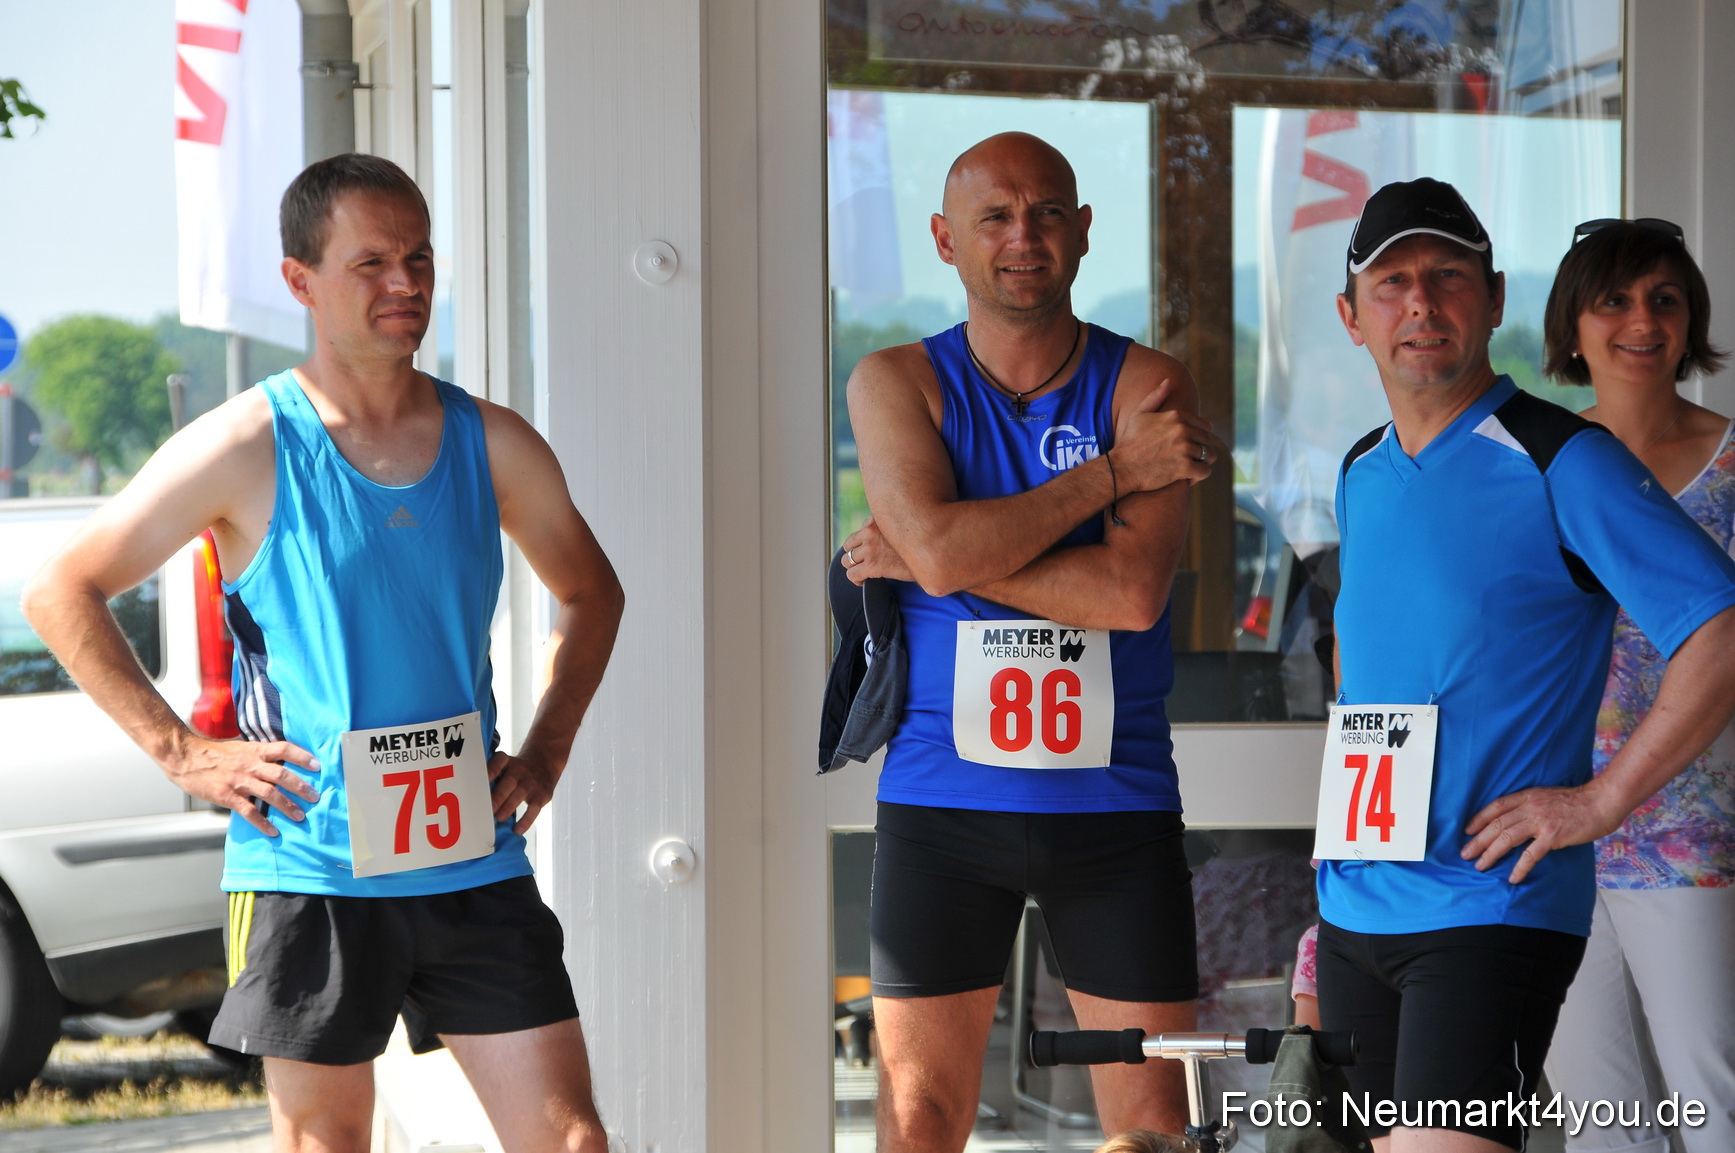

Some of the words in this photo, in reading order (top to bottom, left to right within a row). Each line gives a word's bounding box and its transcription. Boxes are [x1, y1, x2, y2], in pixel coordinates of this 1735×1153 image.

[982, 629, 1055, 645] MEYER
[982, 646, 1055, 659] WERBUNG
[989, 667, 1082, 755] 86
[1341, 713, 1385, 731] MEYER
[369, 728, 440, 753] MEYER
[1340, 731, 1385, 745] WERBUNG
[369, 746, 441, 765] WERBUNG
[1344, 754, 1396, 843] 74
[382, 764, 461, 855] 75
